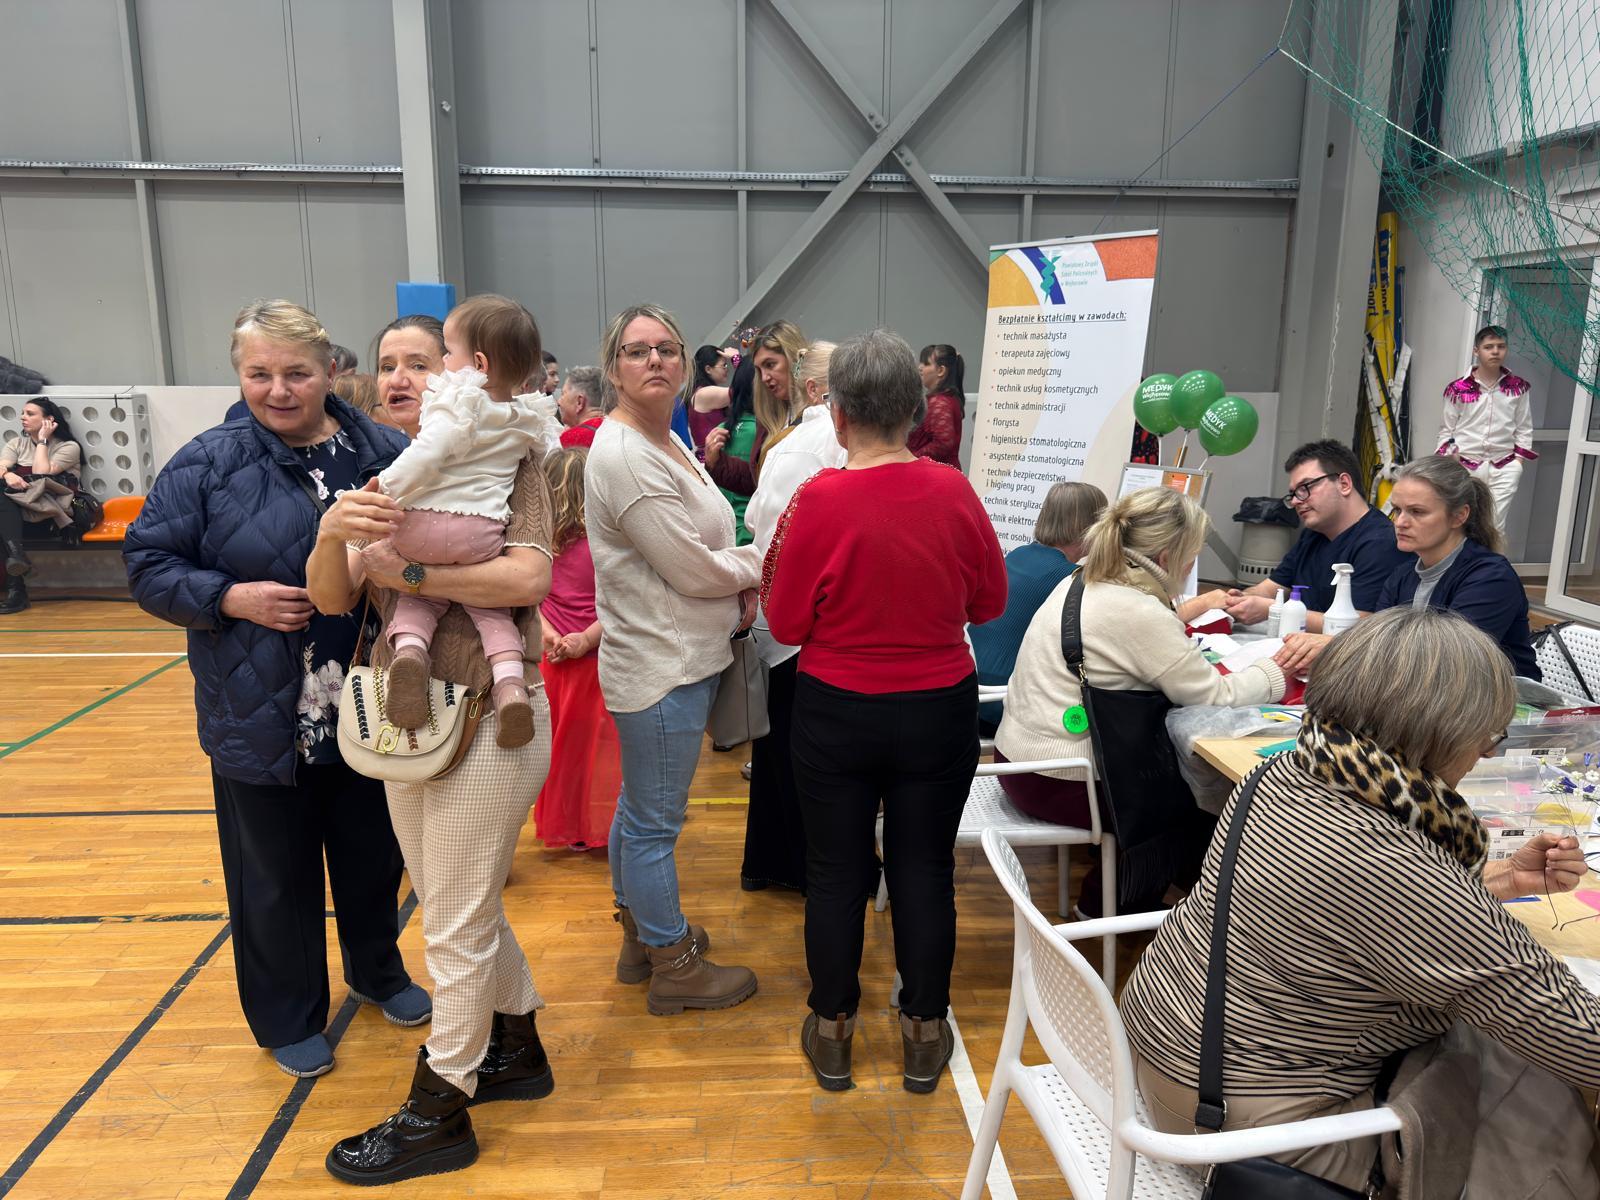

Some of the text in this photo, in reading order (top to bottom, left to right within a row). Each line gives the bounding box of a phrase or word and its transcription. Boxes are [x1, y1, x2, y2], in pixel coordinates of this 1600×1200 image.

[998, 315, 1035, 324] Bezpłatnie
[1037, 313, 1076, 323] kształcimy
[1087, 311, 1127, 320] zawodach:
[1003, 331, 1067, 341] technik masażysta
[1001, 349, 1070, 359] terapeuta zajęciowy
[998, 367, 1062, 377] opiekun medyczny
[996, 384, 1098, 394] technik usług kosmetycznych
[1142, 384, 1173, 393] MEDYK
[995, 401, 1066, 413] technik administracji
[992, 418, 1020, 428] florysta
[1205, 408, 1227, 430] MEDYK
[990, 434, 1087, 449] higienistka stomatologiczna
[988, 452, 1085, 467] asystentka stomatologiczna
[987, 468, 1066, 483] technik bezpieczeństwa
[990, 480, 1014, 492] higieny
[1016, 483, 1035, 493] pracy
[984, 496, 1044, 510] technik sterylizac
[988, 513, 1038, 526] chnik elektrora
[1010, 533, 1031, 543] osoby
